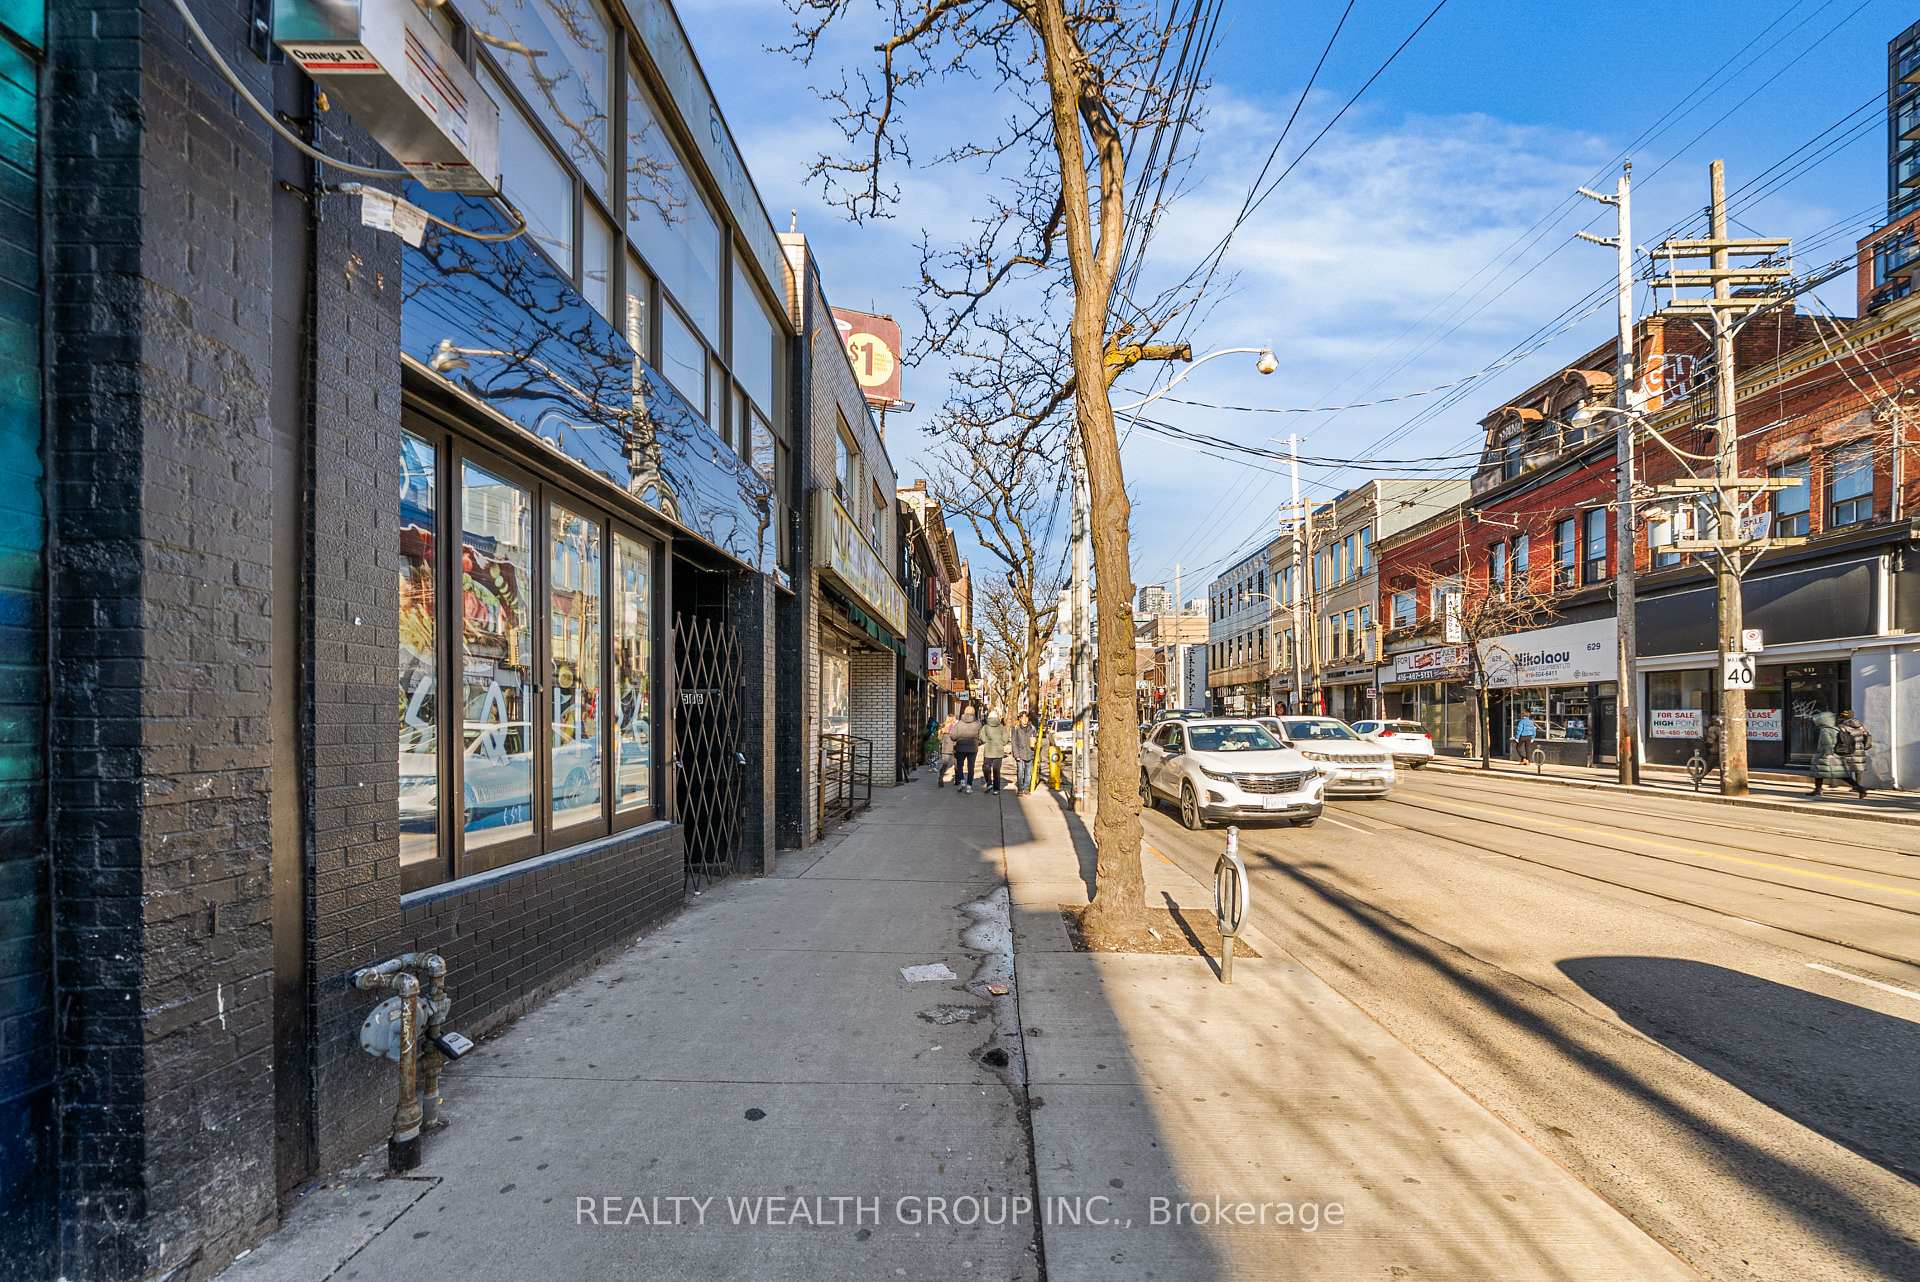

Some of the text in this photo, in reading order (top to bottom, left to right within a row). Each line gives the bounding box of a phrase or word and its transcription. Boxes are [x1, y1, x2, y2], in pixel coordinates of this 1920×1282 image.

[292, 49, 346, 63] Omega
[849, 341, 873, 376] $1
[1586, 643, 1601, 651] 629
[1397, 656, 1408, 665] FOR
[1514, 650, 1570, 667] Nikolaou
[1727, 668, 1752, 684] 40
[1748, 711, 1772, 719] LEASE
[1752, 720, 1778, 728] POINT
